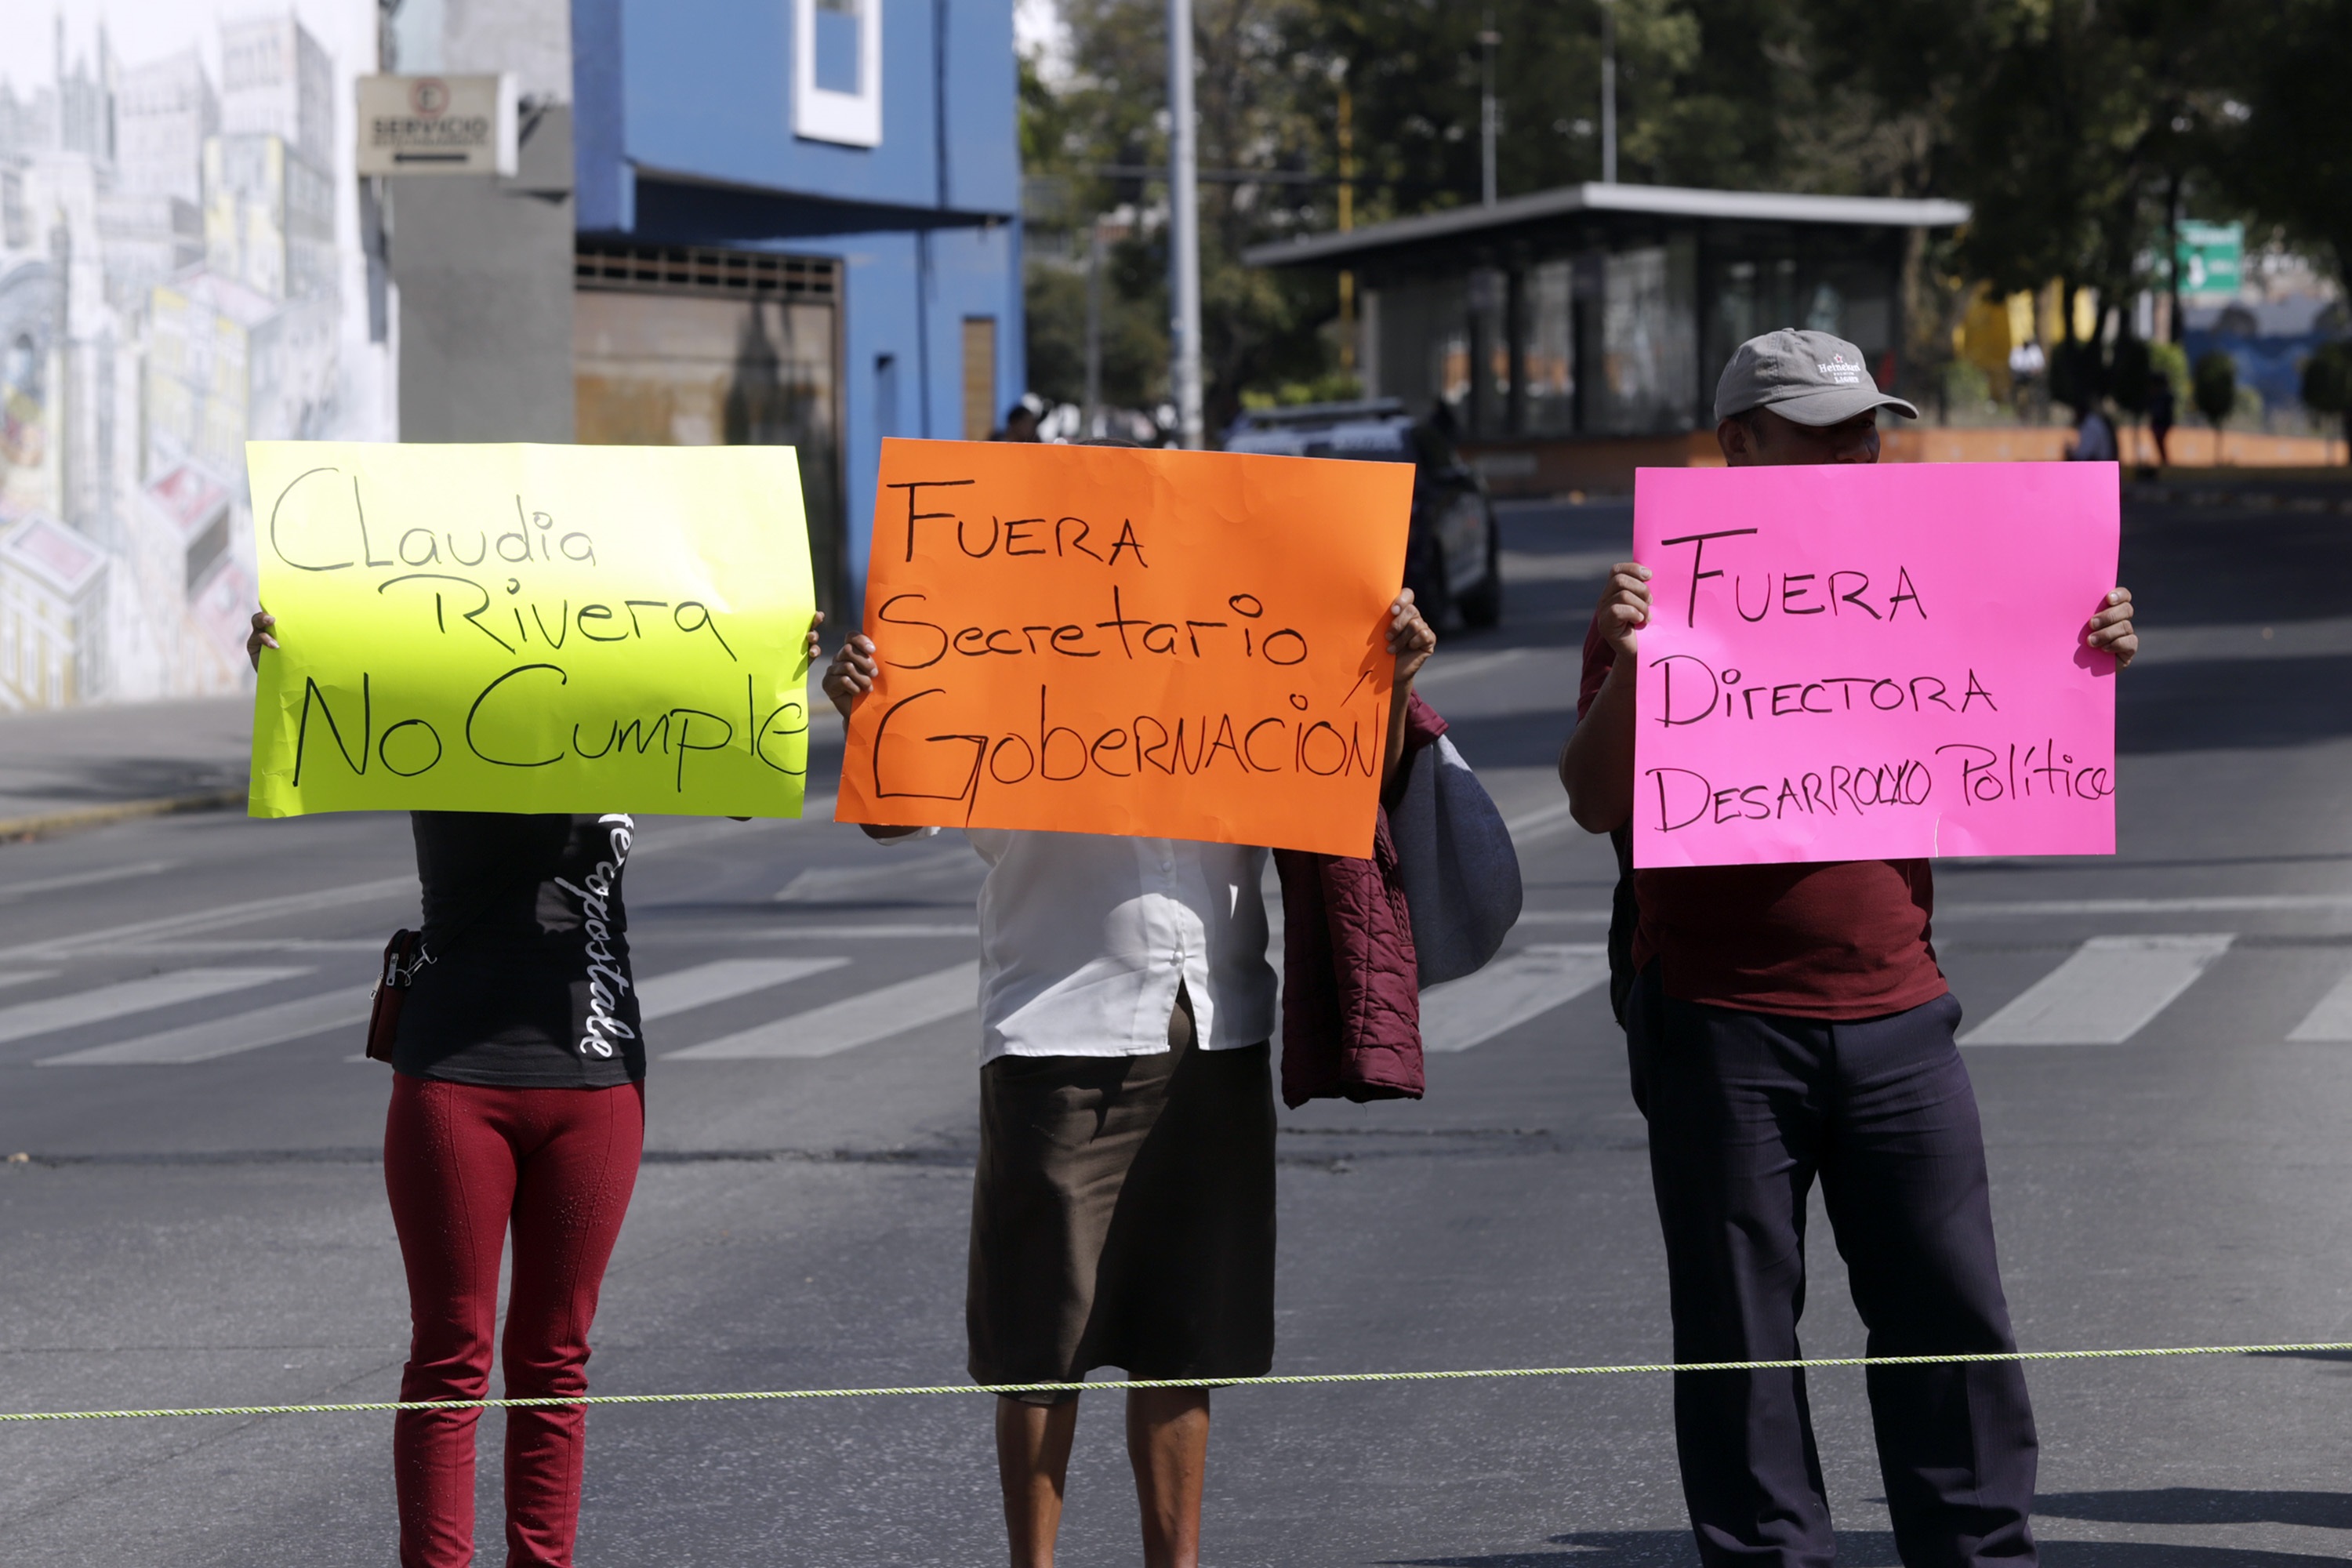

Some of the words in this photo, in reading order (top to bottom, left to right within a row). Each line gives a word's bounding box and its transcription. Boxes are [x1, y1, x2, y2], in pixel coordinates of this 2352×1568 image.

[885, 479, 1149, 569] FUERA
[377, 573, 738, 662] Rivera
[1661, 527, 1928, 629] FUERA
[877, 584, 1308, 670] Secretario
[292, 671, 442, 788] No
[465, 662, 809, 793] Cumple
